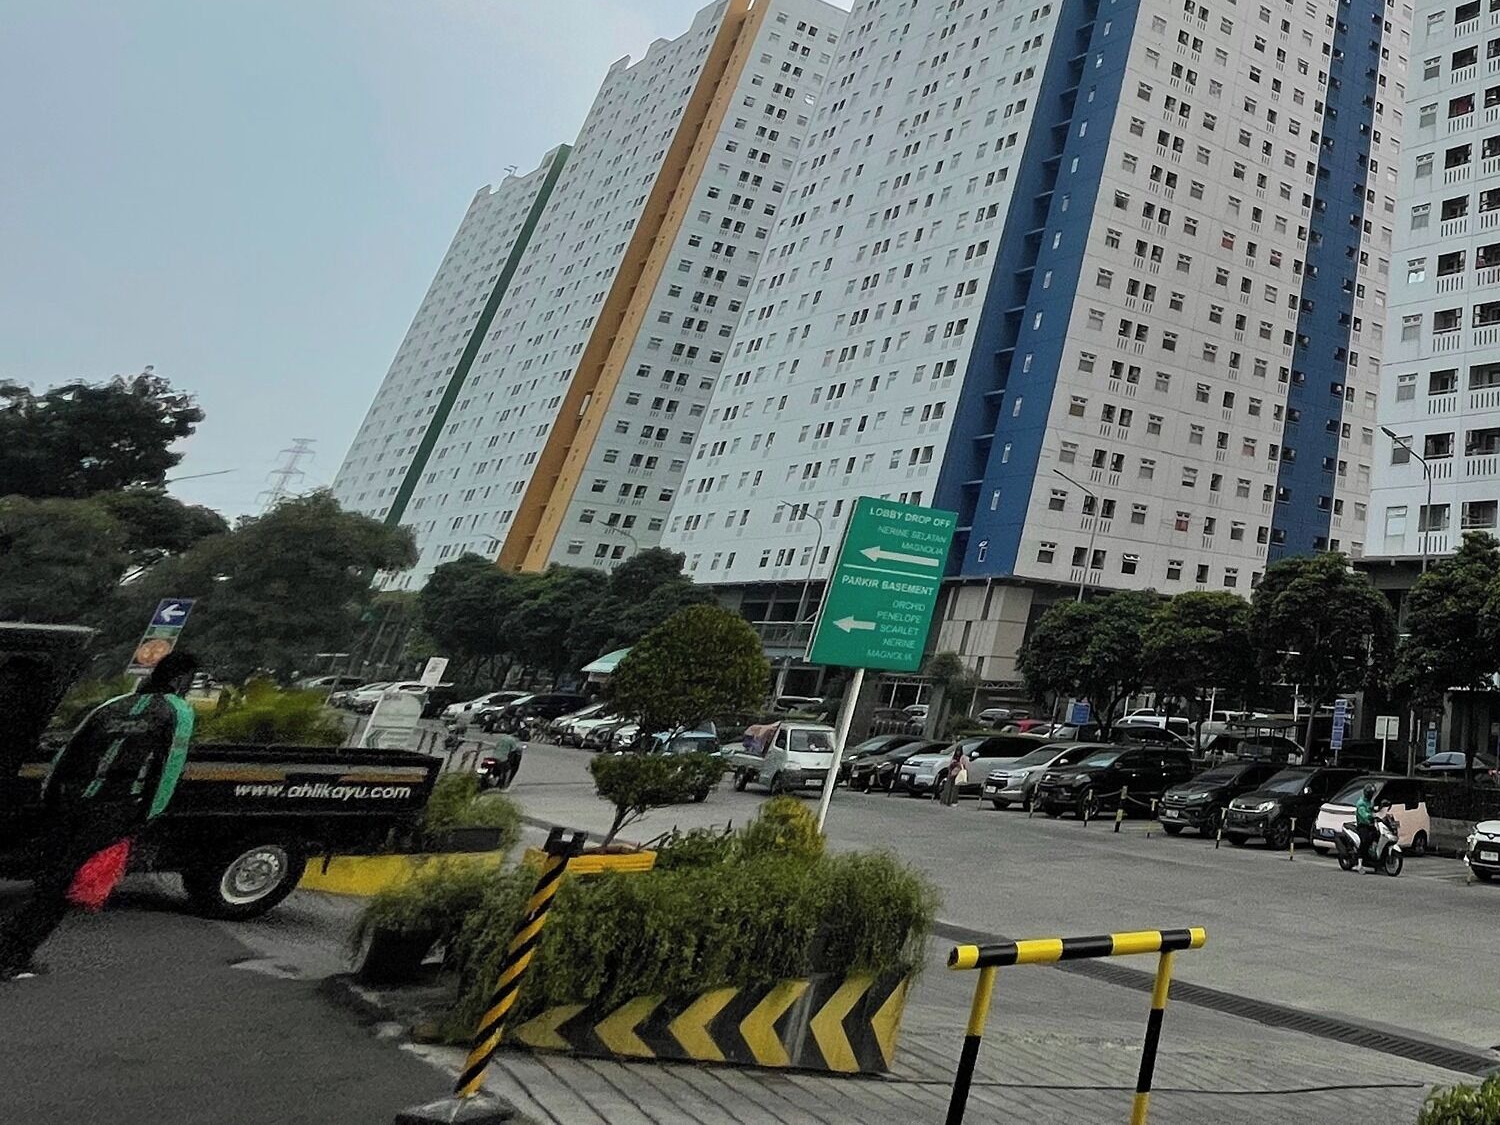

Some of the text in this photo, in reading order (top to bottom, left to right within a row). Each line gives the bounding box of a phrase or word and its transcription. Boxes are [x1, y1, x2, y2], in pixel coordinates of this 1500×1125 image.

[869, 507, 952, 528] LOBBY DROP OFF
[911, 530, 947, 543] SELATAN
[901, 542, 944, 555] MAGNOLIA
[841, 574, 935, 596] PARKIR BASEMENT
[892, 600, 926, 611] ORCHID
[876, 611, 922, 623] PENELOPE
[879, 624, 920, 636] SCARLET
[234, 782, 411, 801] www.ahlikayu.com
